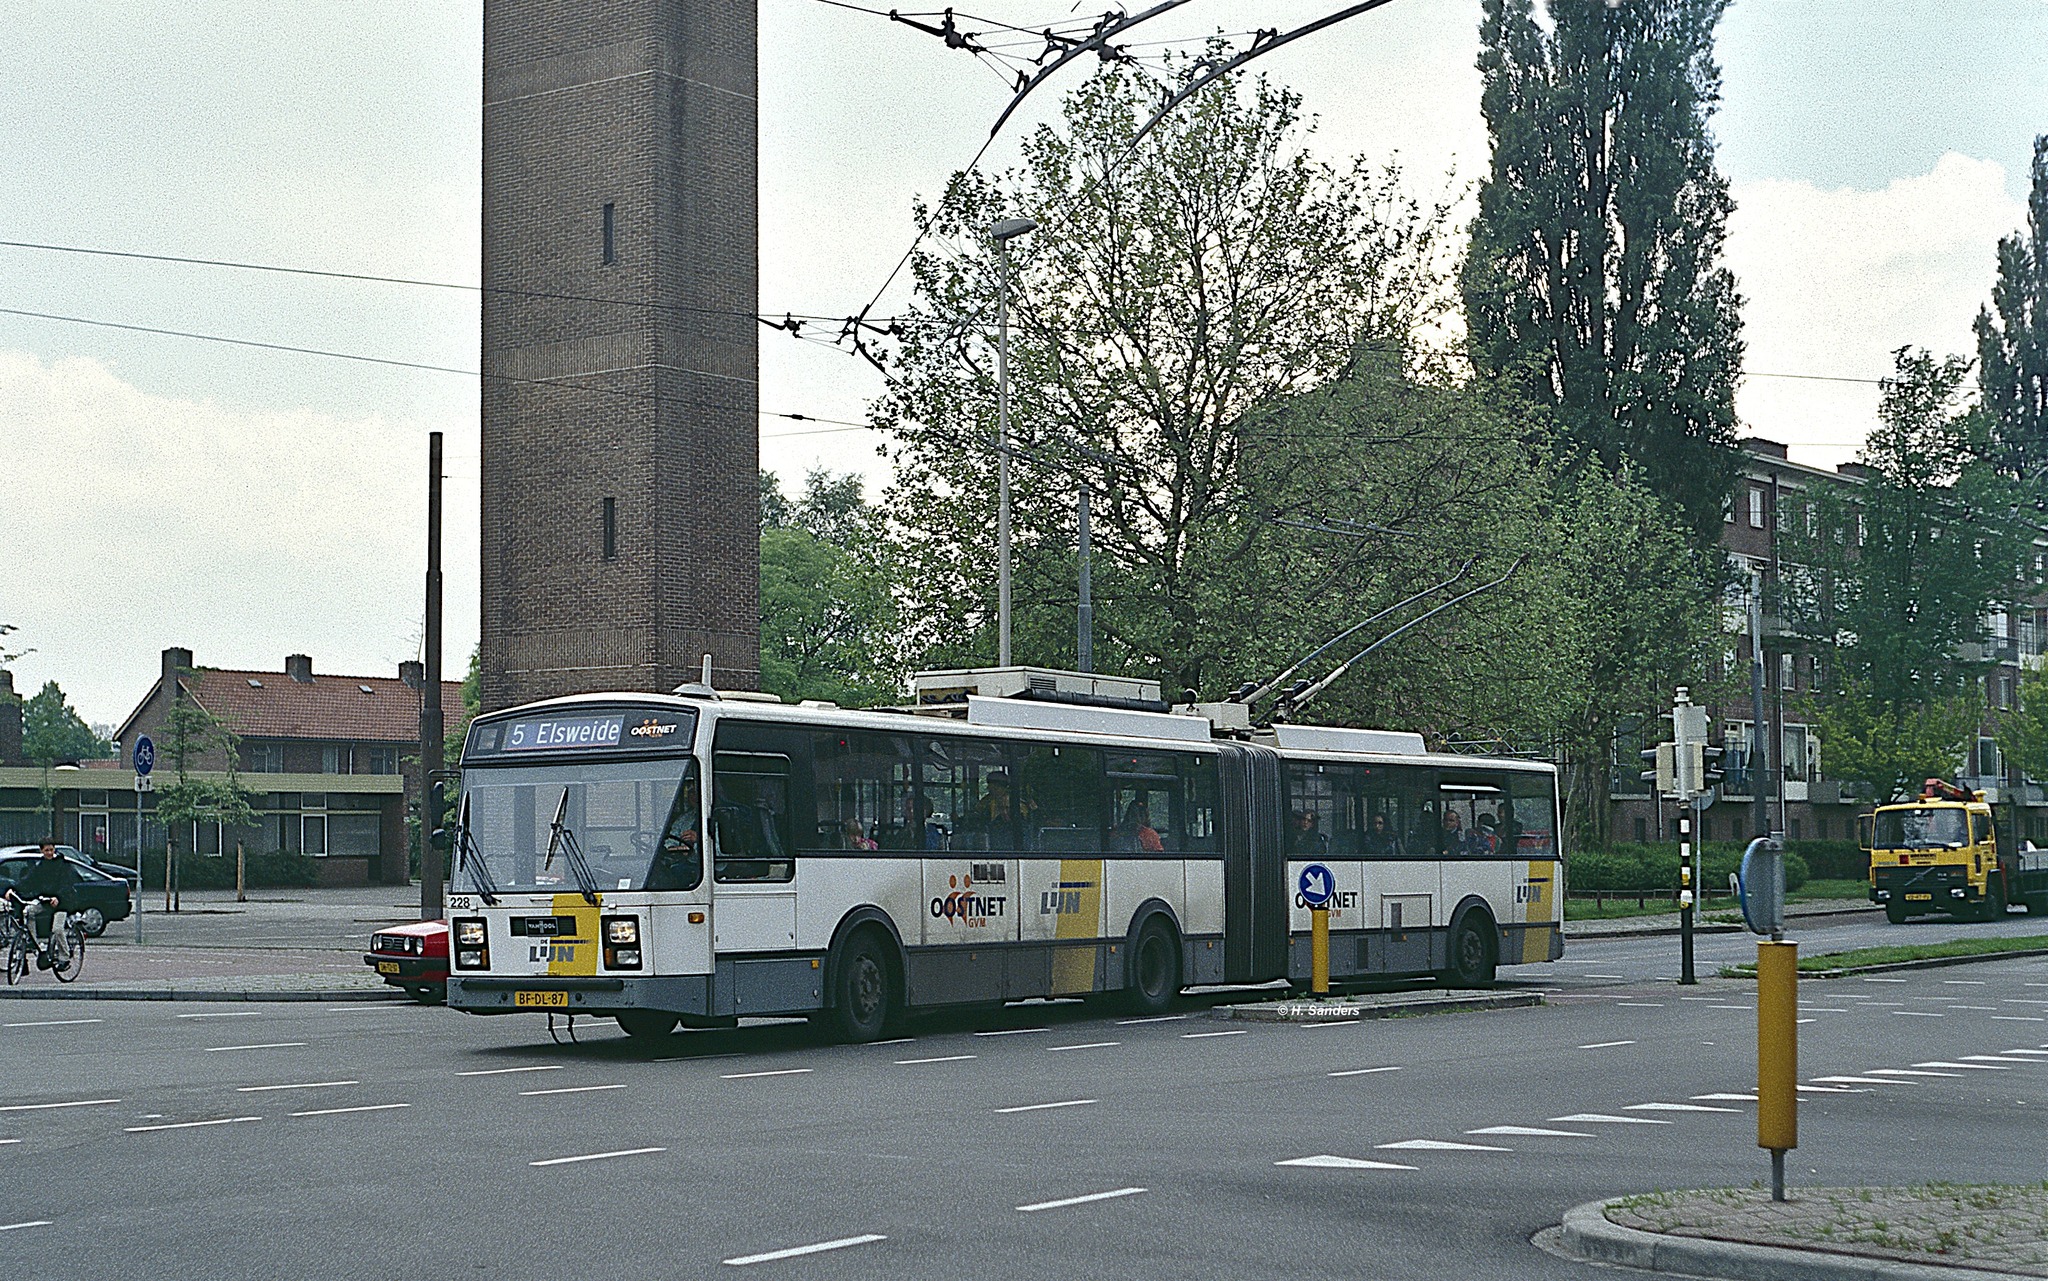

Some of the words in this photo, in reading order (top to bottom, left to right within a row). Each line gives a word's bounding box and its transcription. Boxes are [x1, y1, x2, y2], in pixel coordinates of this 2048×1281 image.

[511, 724, 526, 746] 5
[537, 720, 620, 744] Elsweide
[630, 724, 677, 736] OOSTNET
[450, 897, 470, 908] 228
[930, 896, 1006, 918] OOSTNET
[1295, 892, 1358, 909] ONET
[968, 918, 986, 928] GVM
[518, 992, 565, 1005] BF-DL-87
